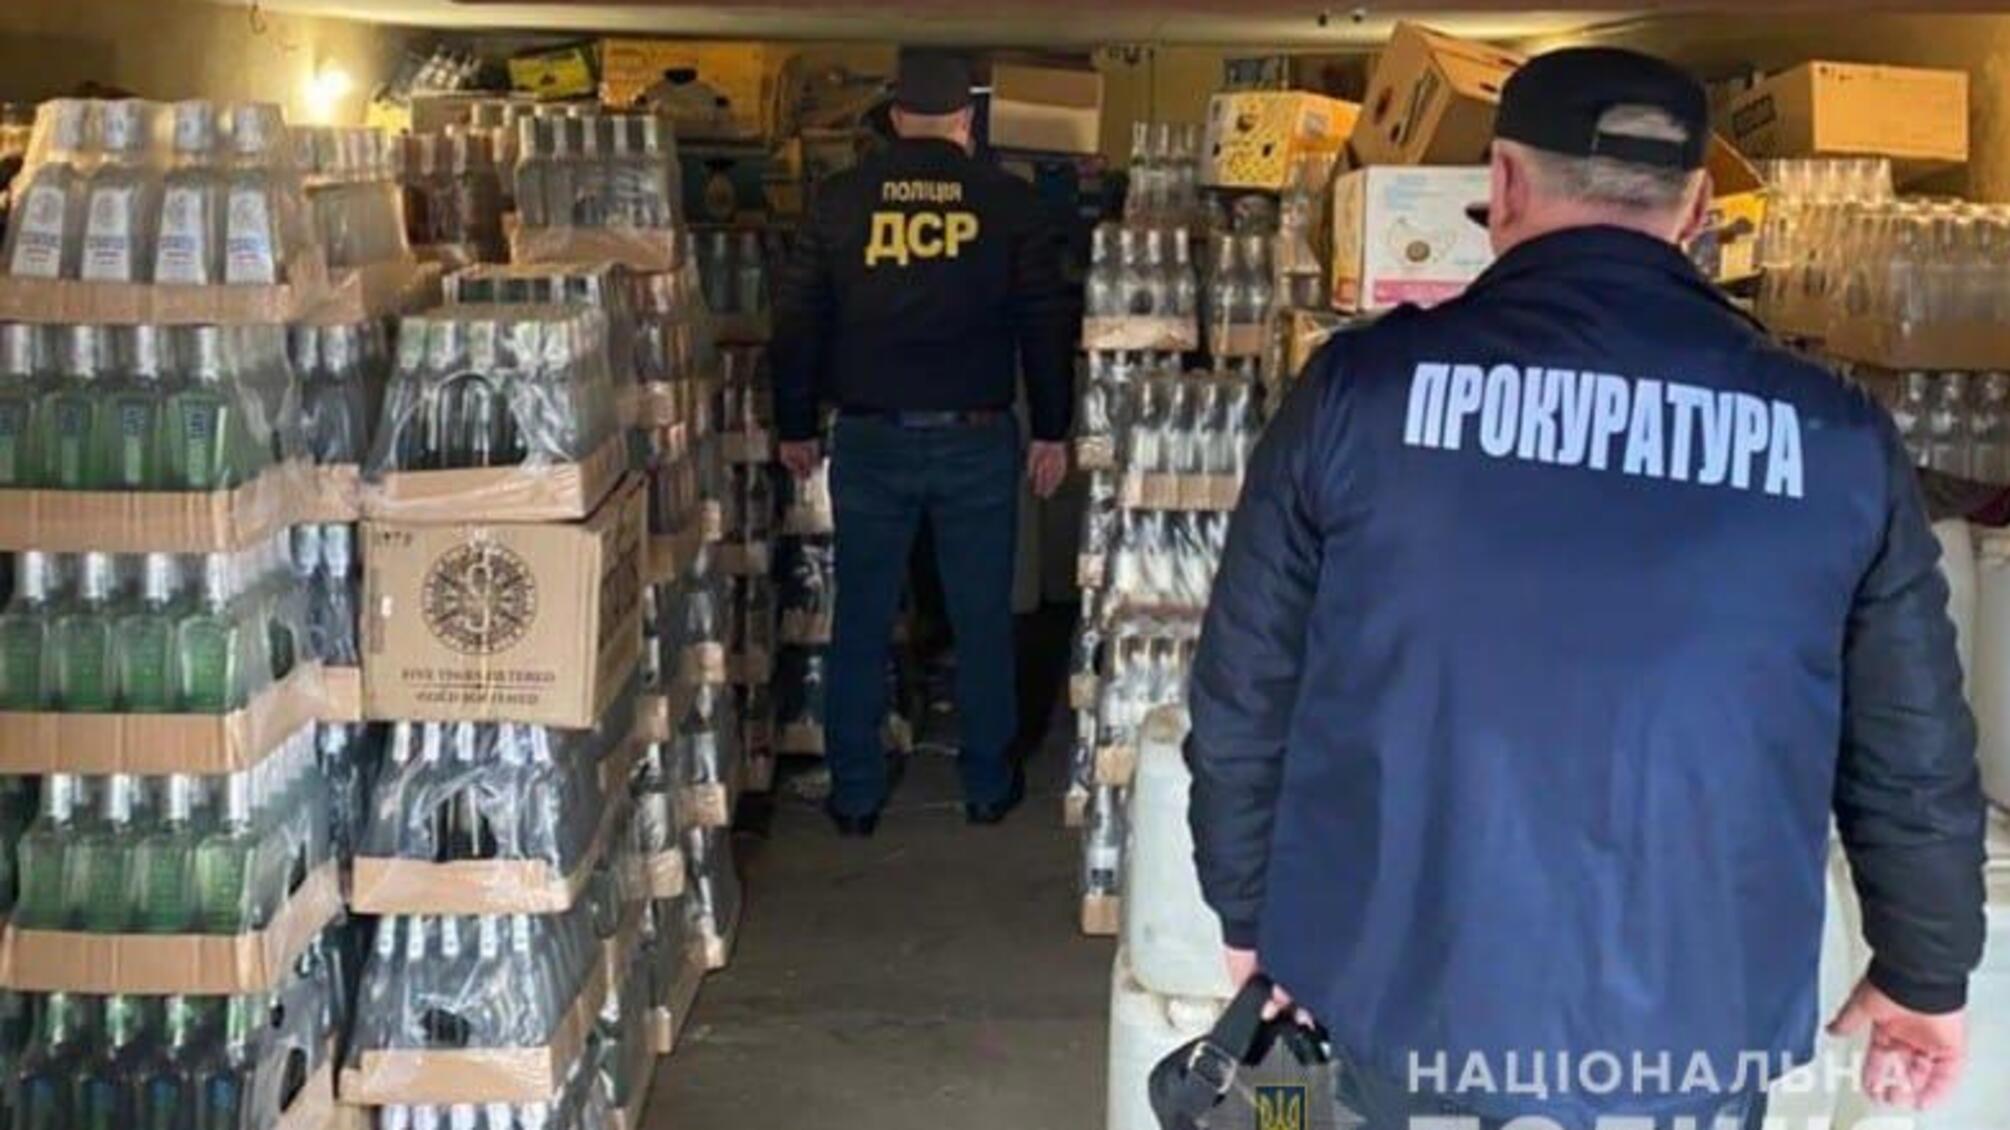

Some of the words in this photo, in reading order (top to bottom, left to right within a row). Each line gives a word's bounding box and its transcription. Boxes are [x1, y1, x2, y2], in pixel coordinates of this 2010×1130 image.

[882, 181, 962, 202] ПОЛІЦІЯ
[865, 211, 979, 266] ДСР
[1404, 362, 1804, 499] ПРОКУРАТУРА
